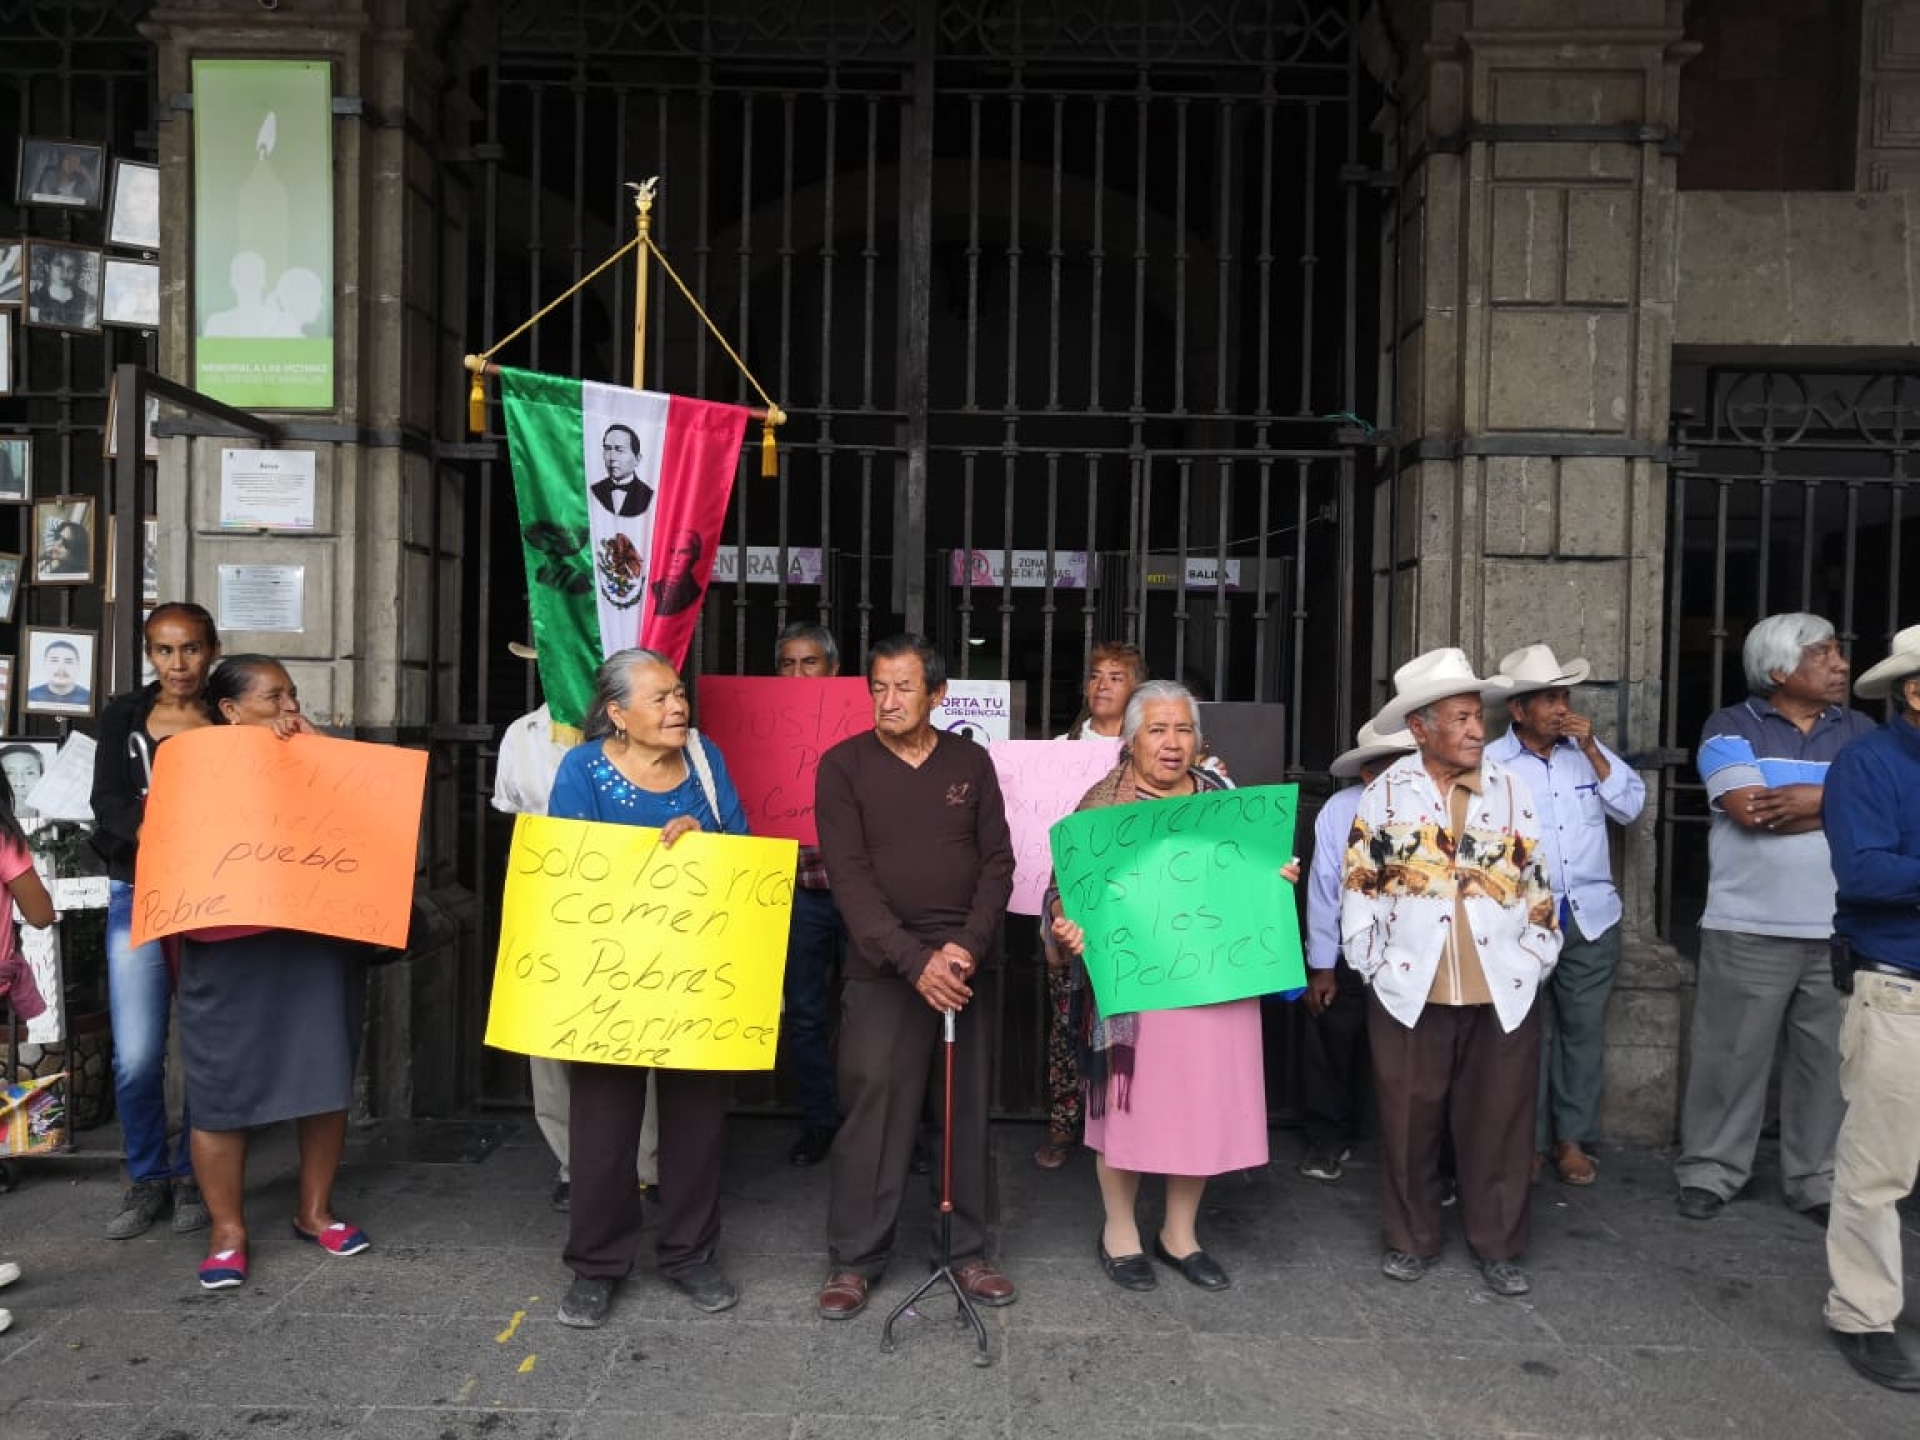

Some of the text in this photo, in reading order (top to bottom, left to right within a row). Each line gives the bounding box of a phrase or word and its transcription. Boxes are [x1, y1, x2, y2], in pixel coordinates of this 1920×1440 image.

[941, 697, 1004, 709] ORTA TU
[944, 708, 1008, 718] CREDENCIAL
[213, 841, 361, 880] pueblo
[633, 840, 708, 897] los
[139, 887, 232, 936] Pobre
[1151, 900, 1223, 942] los
[581, 937, 737, 1000] Pobres
[1110, 926, 1282, 1000] Pobres
[550, 1028, 672, 1066] Ambre
